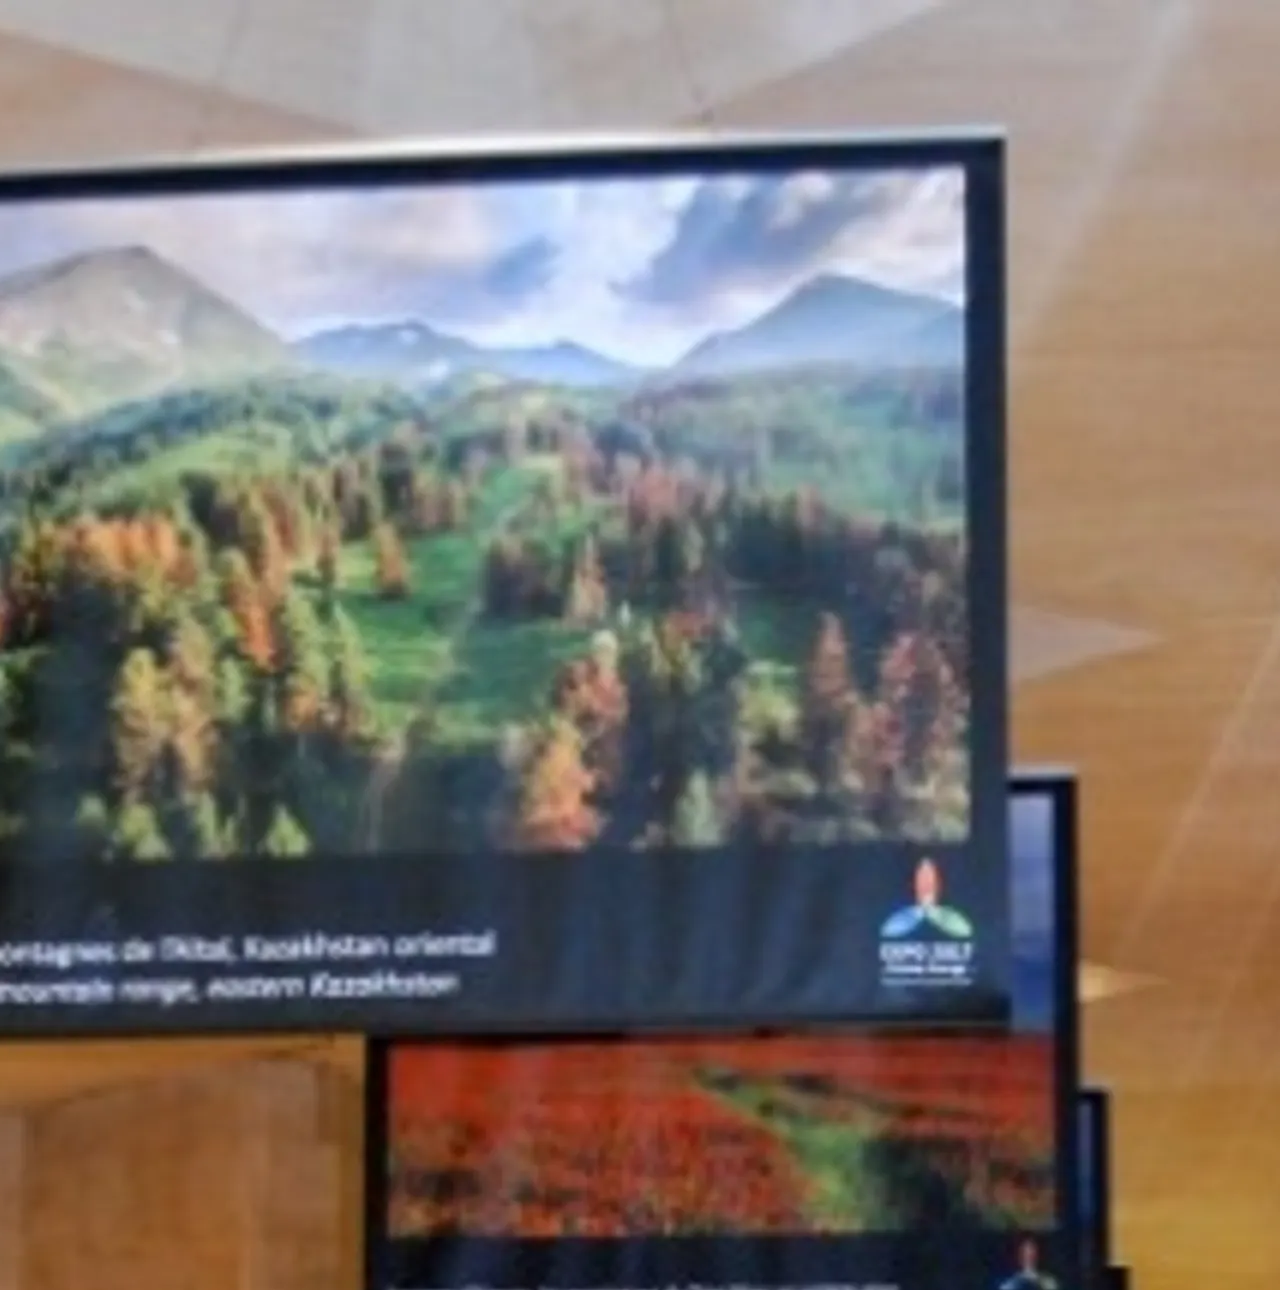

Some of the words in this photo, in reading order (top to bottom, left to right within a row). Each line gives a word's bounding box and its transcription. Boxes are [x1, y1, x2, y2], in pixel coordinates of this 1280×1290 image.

[122, 937, 153, 962] de
[243, 931, 388, 962] Kazakhstan
[393, 929, 496, 959] oriental
[206, 976, 306, 1000] eastern
[309, 969, 461, 999] Kazakhstan
